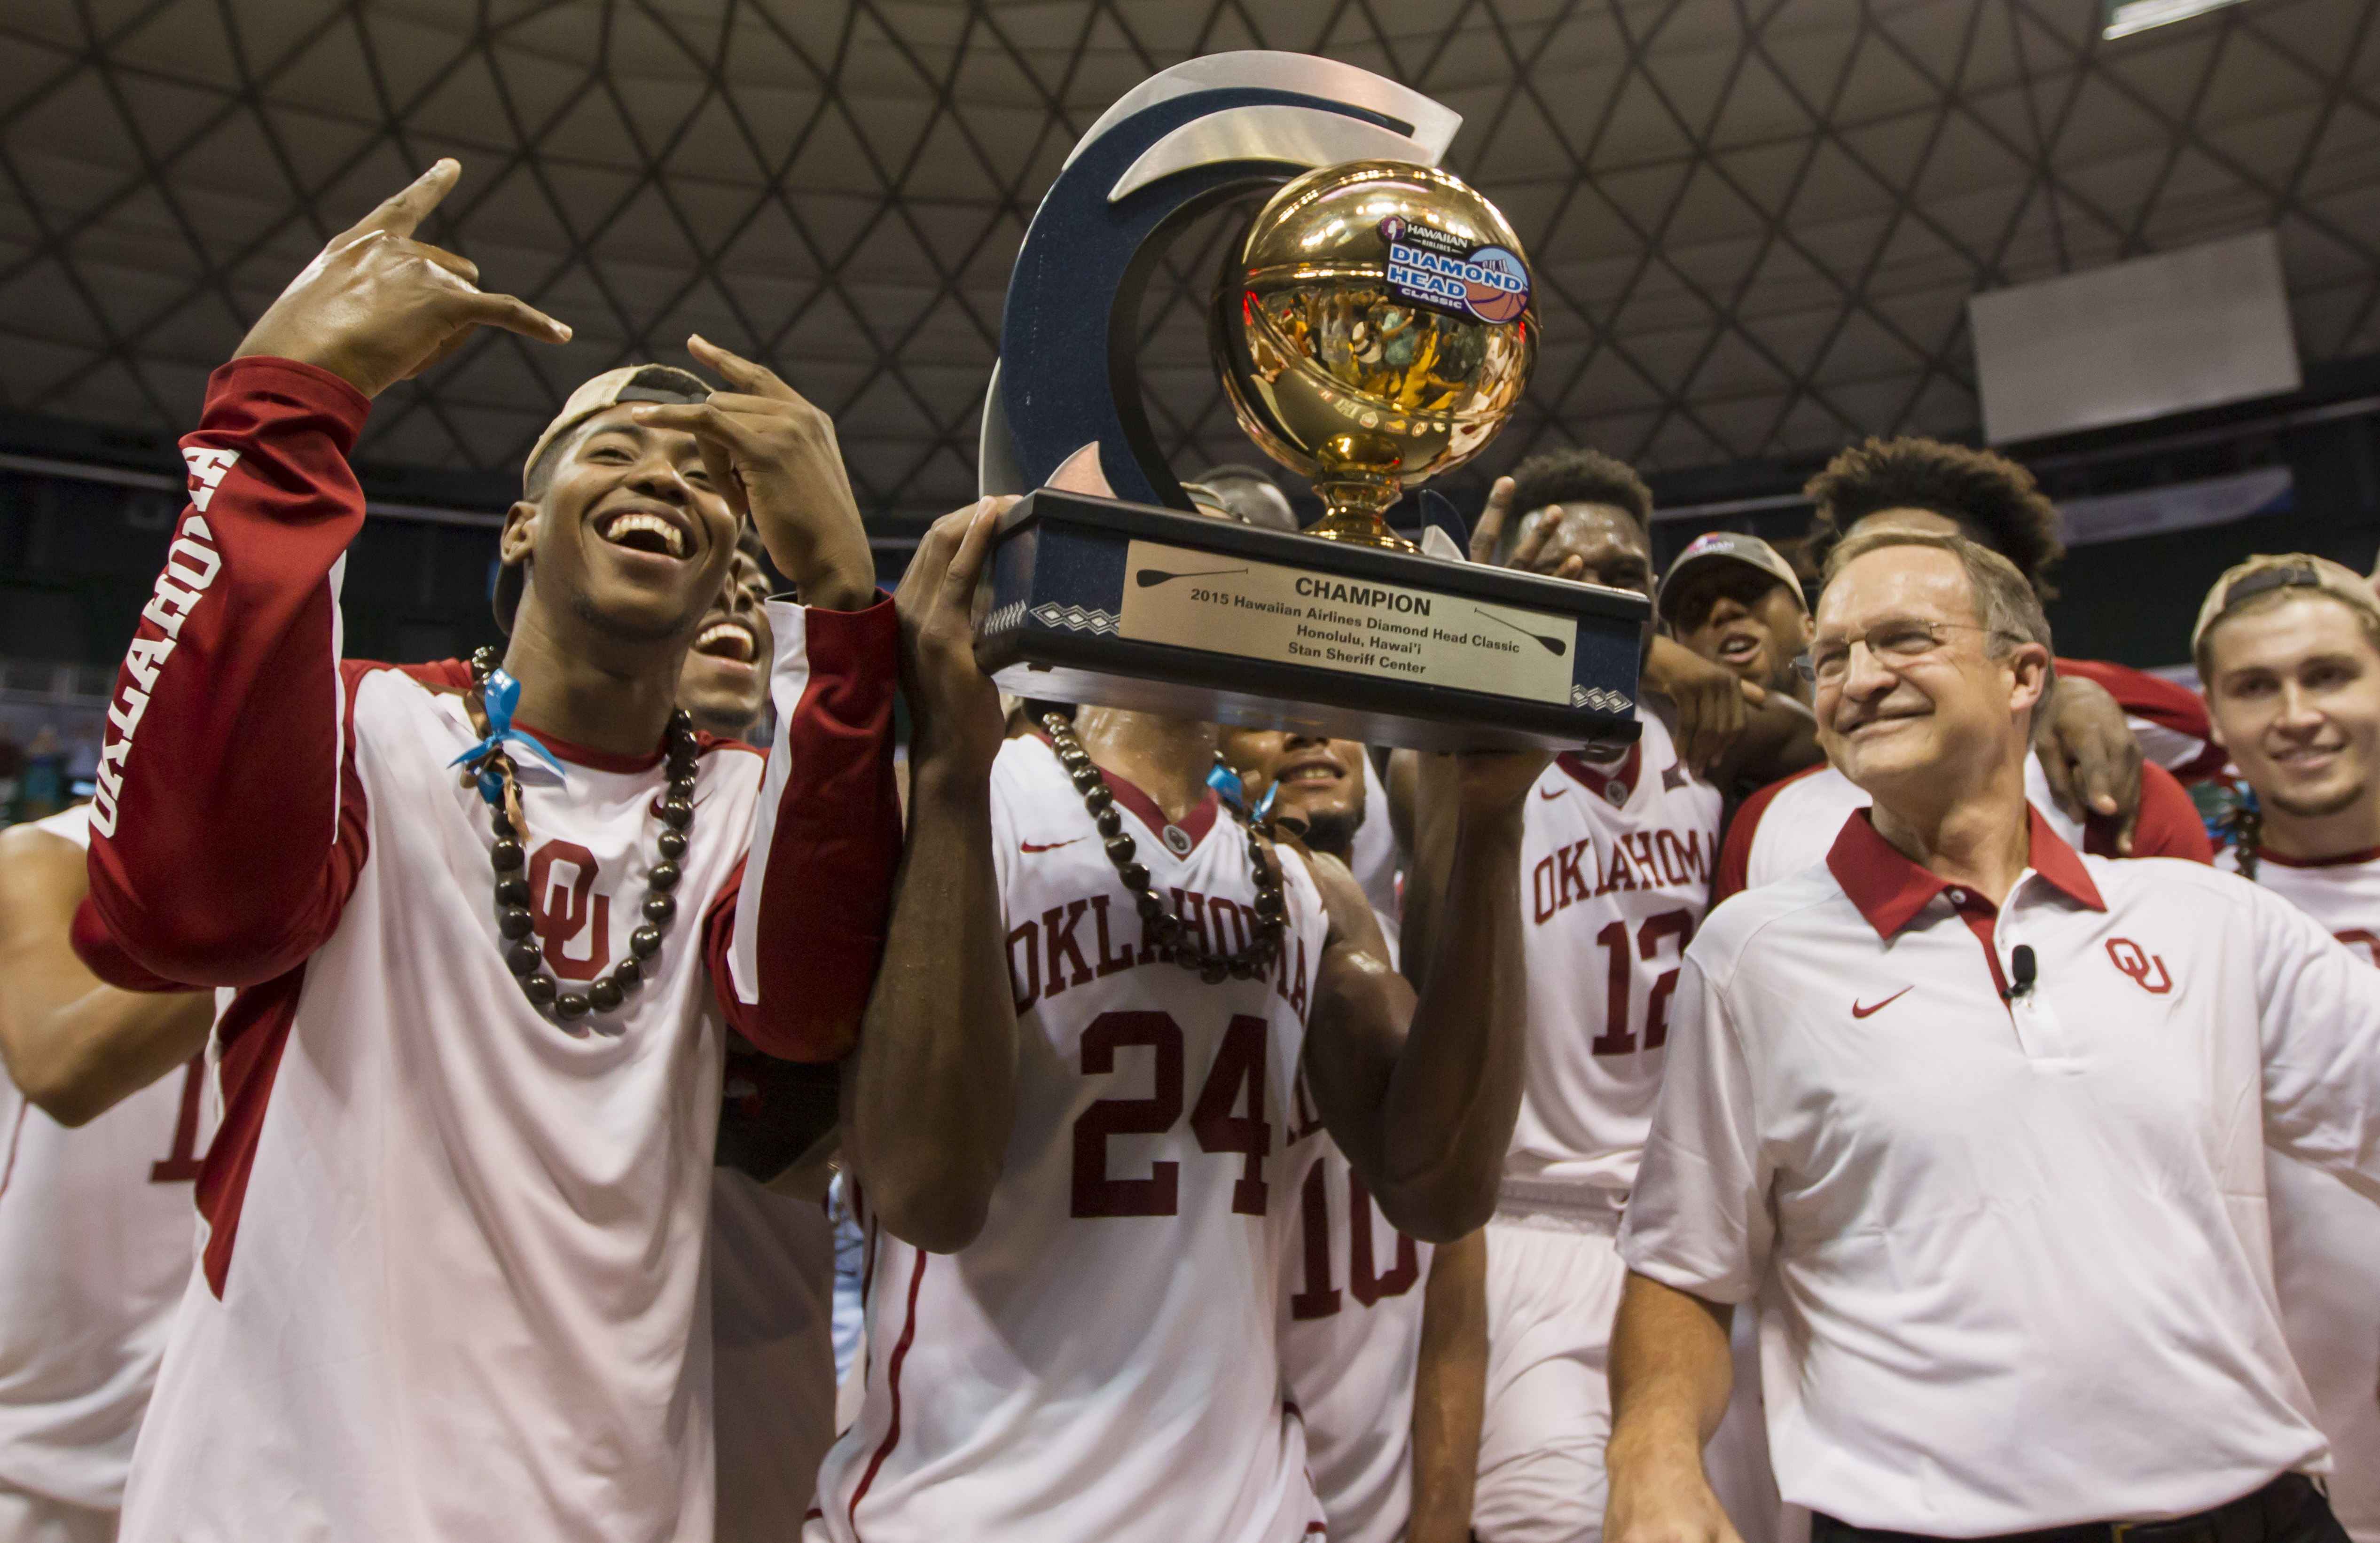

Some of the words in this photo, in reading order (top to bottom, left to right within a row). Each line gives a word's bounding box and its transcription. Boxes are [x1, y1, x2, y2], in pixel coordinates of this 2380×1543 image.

[1408, 224, 1468, 249] HAWAIIAN
[1387, 263, 1467, 299] HEAD
[1390, 243, 1523, 293] DIAMOND
[1401, 288, 1463, 309] CLASSIC
[1295, 577, 1431, 616] CHAMPION
[1190, 588, 1229, 605] 2015
[1234, 595, 1302, 617] Hawaiian
[1307, 608, 1362, 627] Airlines
[1367, 617, 1428, 638] Diamond
[1433, 628, 1468, 644] Head
[1472, 635, 1520, 653] Classic
[1297, 624, 1365, 647] Honolulu,
[1288, 642, 1321, 658] Stan
[1326, 648, 1376, 666] Sheriff
[1379, 656, 1426, 674] Center
[528, 838, 610, 981] OU
[1592, 908, 1693, 1056] 12
[2104, 938, 2173, 995] OU
[1070, 1010, 1271, 1218] 24
